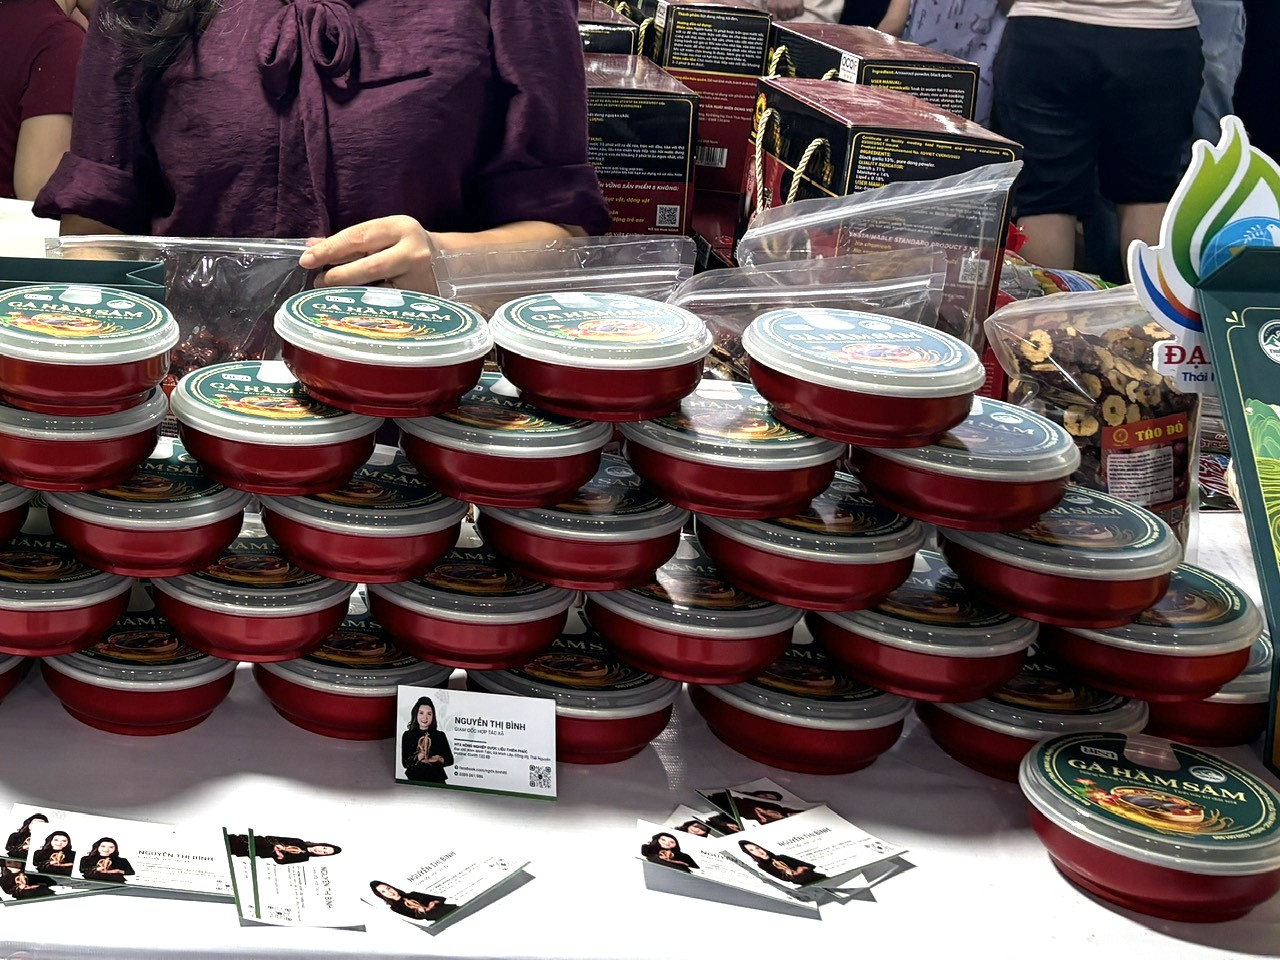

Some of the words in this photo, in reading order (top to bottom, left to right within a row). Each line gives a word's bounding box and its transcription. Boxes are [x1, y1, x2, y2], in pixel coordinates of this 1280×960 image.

[1163, 344, 1211, 370] ĐẠ
[1181, 371, 1208, 383] Thái
[1166, 419, 1185, 436] ĐỎ
[454, 716, 489, 728] NGUYỄN
[489, 720, 504, 731] THỊ
[505, 720, 526, 731] BÌNH
[1067, 758, 1106, 774] GÀ
[1106, 766, 1179, 790] HẦM
[1182, 778, 1248, 804] SÂM
